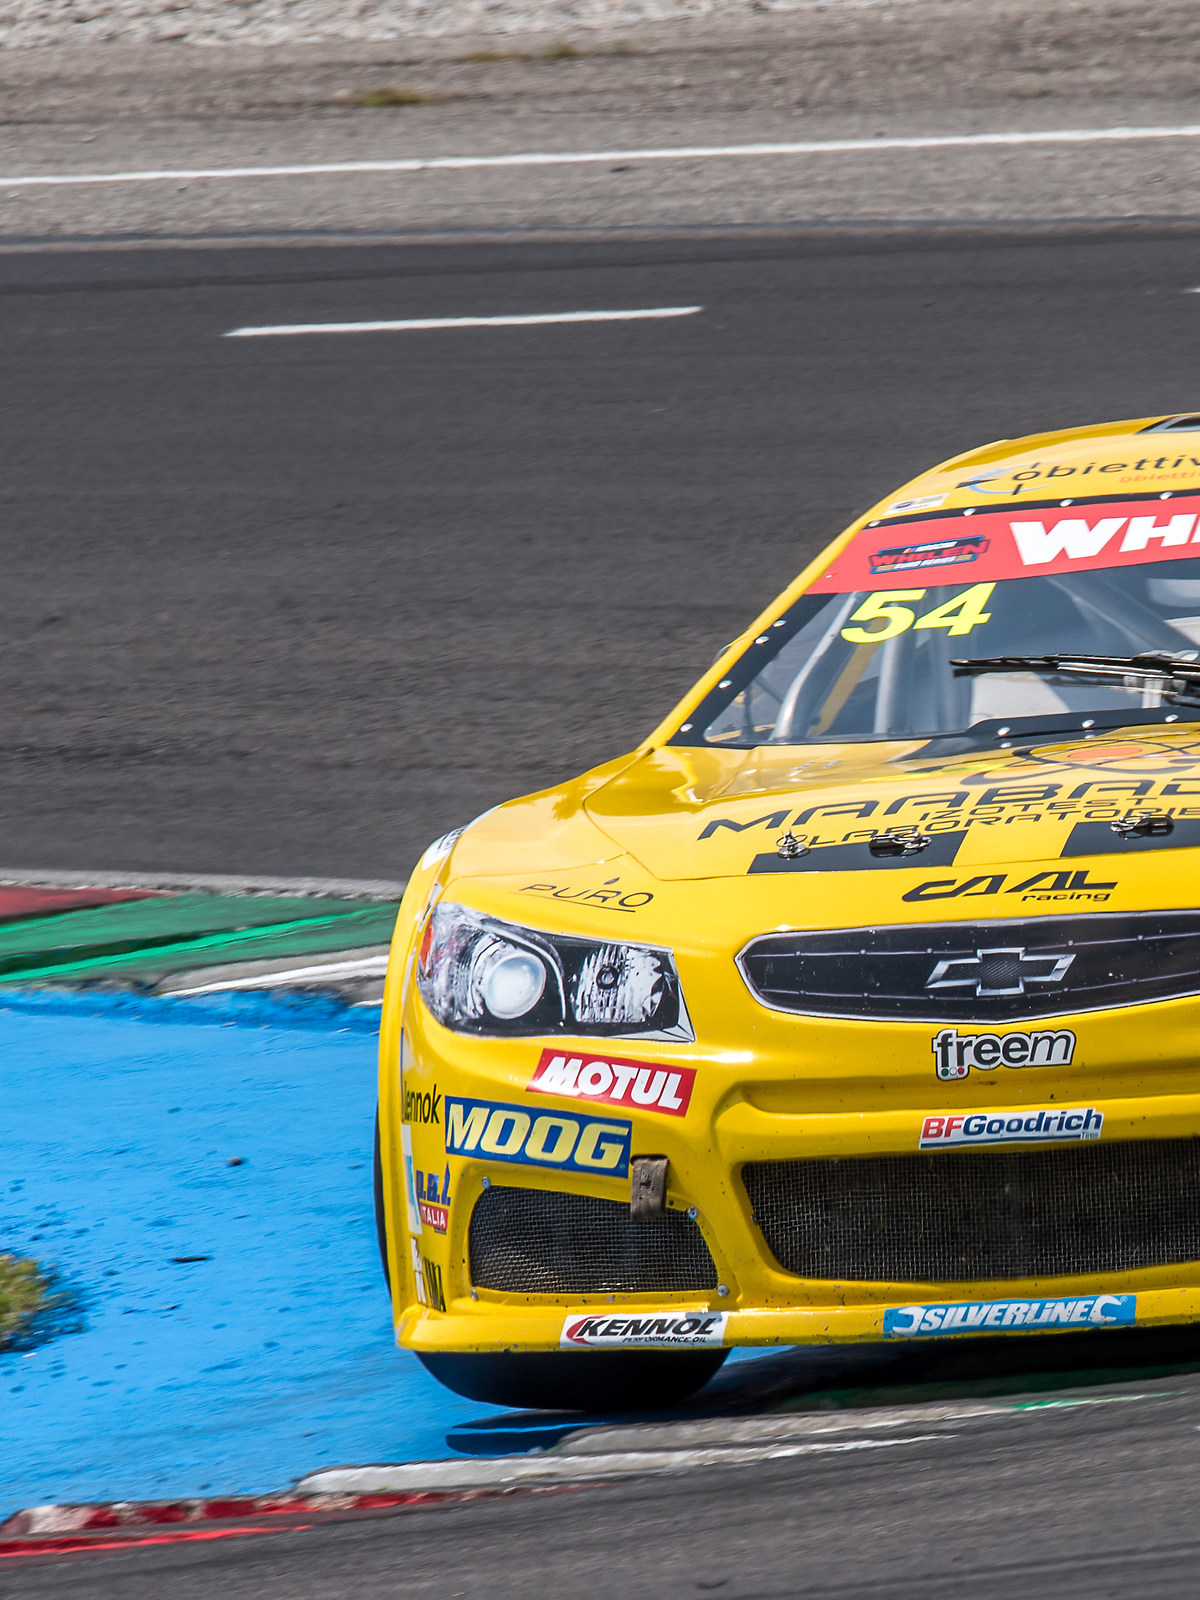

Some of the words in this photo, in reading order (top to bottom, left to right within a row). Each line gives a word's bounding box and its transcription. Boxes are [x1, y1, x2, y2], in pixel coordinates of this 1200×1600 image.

[870, 540, 989, 567] WHELEN
[841, 582, 997, 643] 54
[919, 797, 1157, 821] IZOTEST
[1021, 891, 1111, 902] racing
[936, 1031, 1071, 1069] freem
[535, 1056, 683, 1110] MOTUL
[446, 1103, 630, 1169] MOOG
[922, 1109, 1103, 1139] BFGoodrich
[576, 1317, 716, 1338] KENNOL
